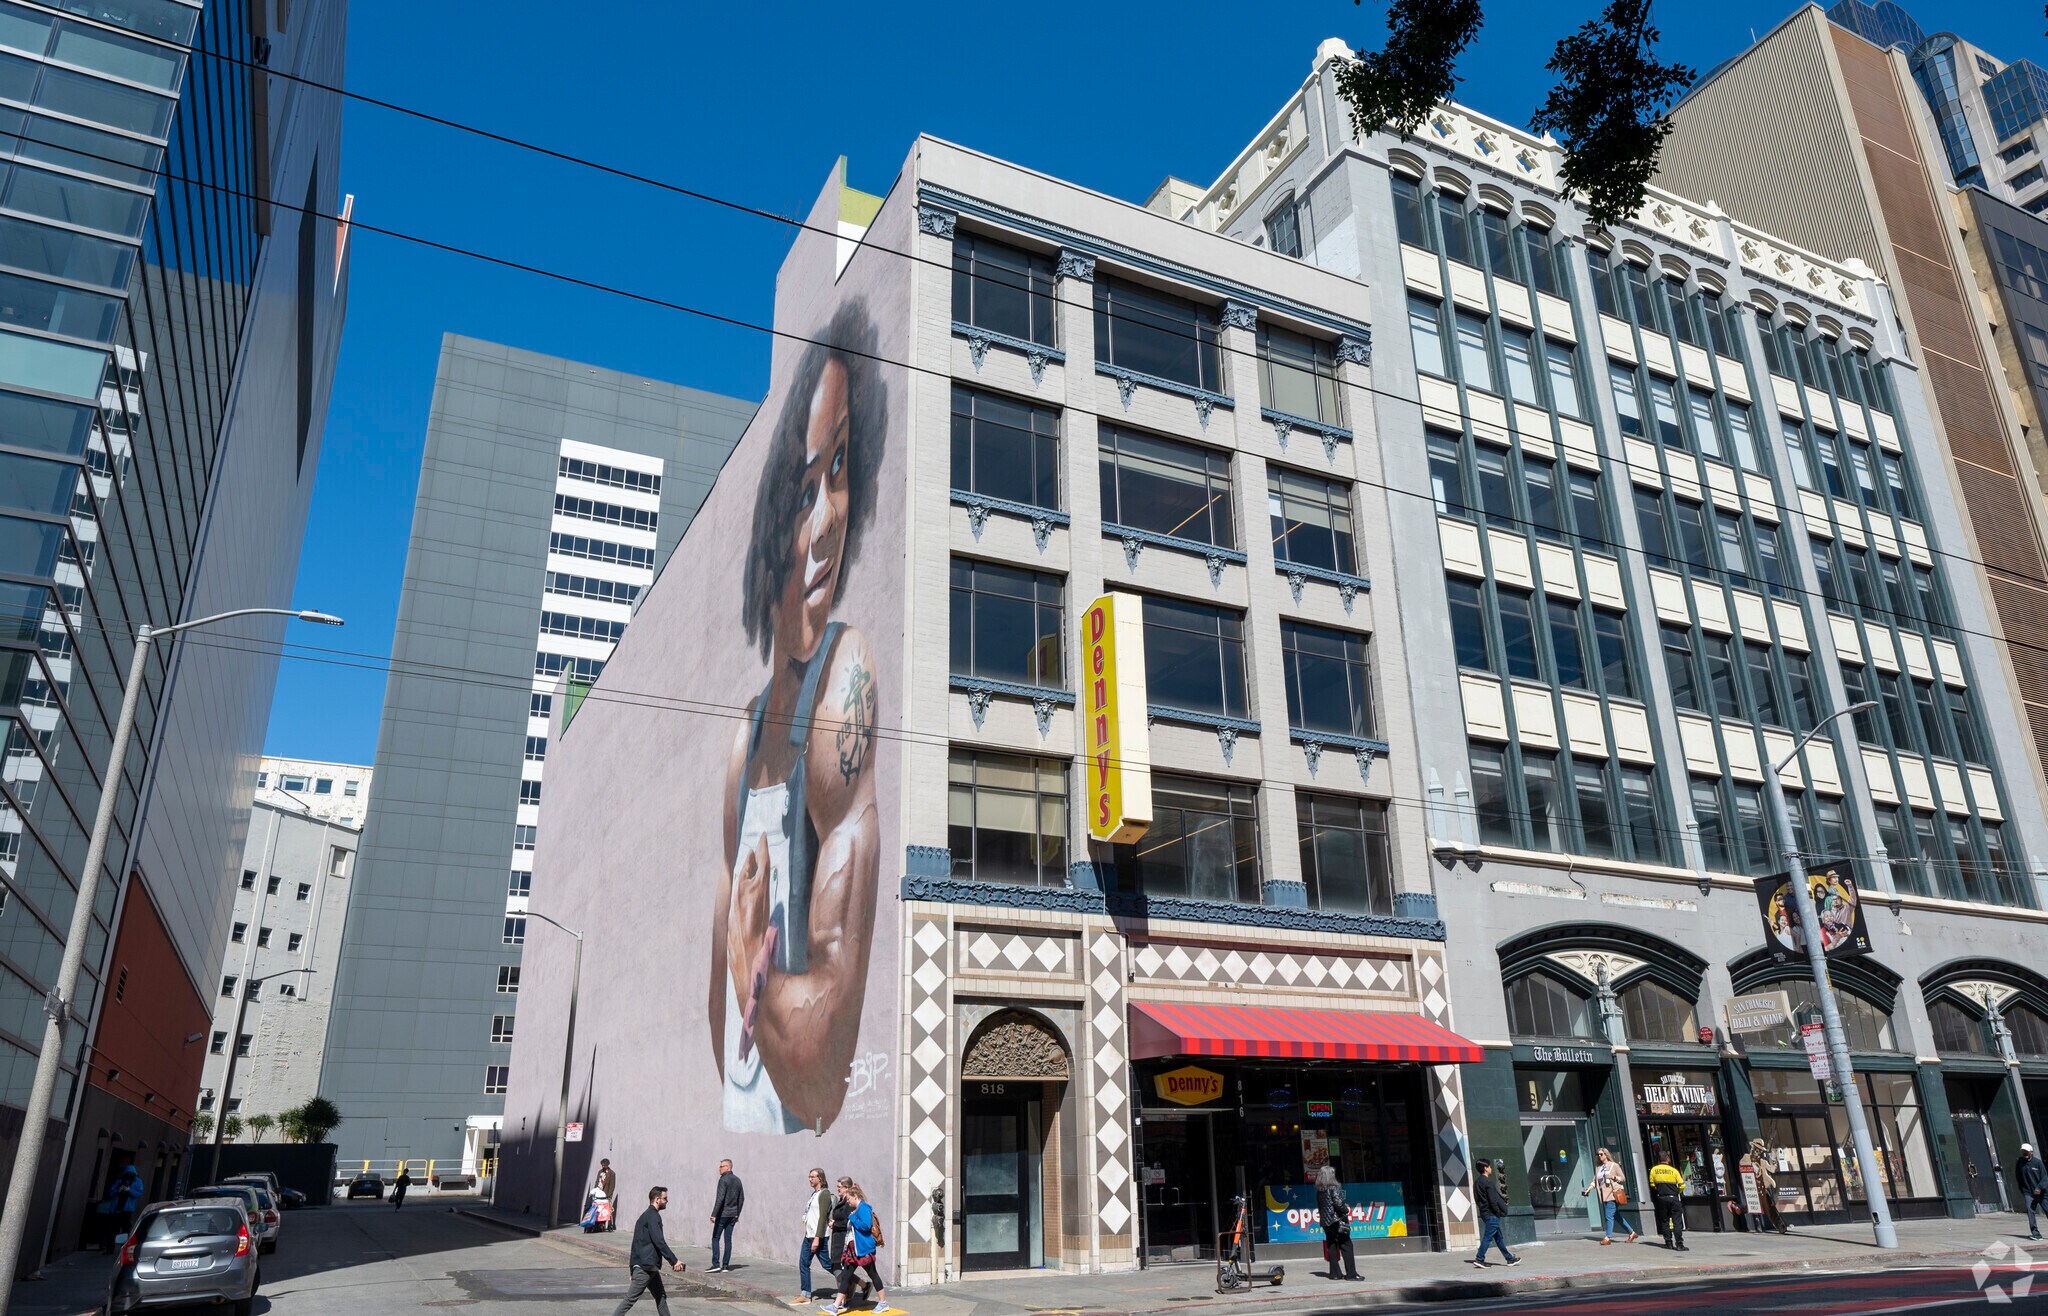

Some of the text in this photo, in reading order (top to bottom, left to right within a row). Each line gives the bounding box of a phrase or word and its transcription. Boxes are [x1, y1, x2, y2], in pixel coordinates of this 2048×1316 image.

[1744, 999, 1776, 1010] FRANCISCO
[1732, 1012, 1785, 1029] DELI & WINE
[1533, 1046, 1593, 1062] The Bulletin
[981, 1083, 1005, 1094] 818
[1167, 1076, 1218, 1095] Denny's
[1644, 1086, 1707, 1104] DELI & WINE
[1310, 1103, 1330, 1112] OPEN
[1672, 1104, 1685, 1114] 810
[1286, 1208, 1321, 1230] ope
